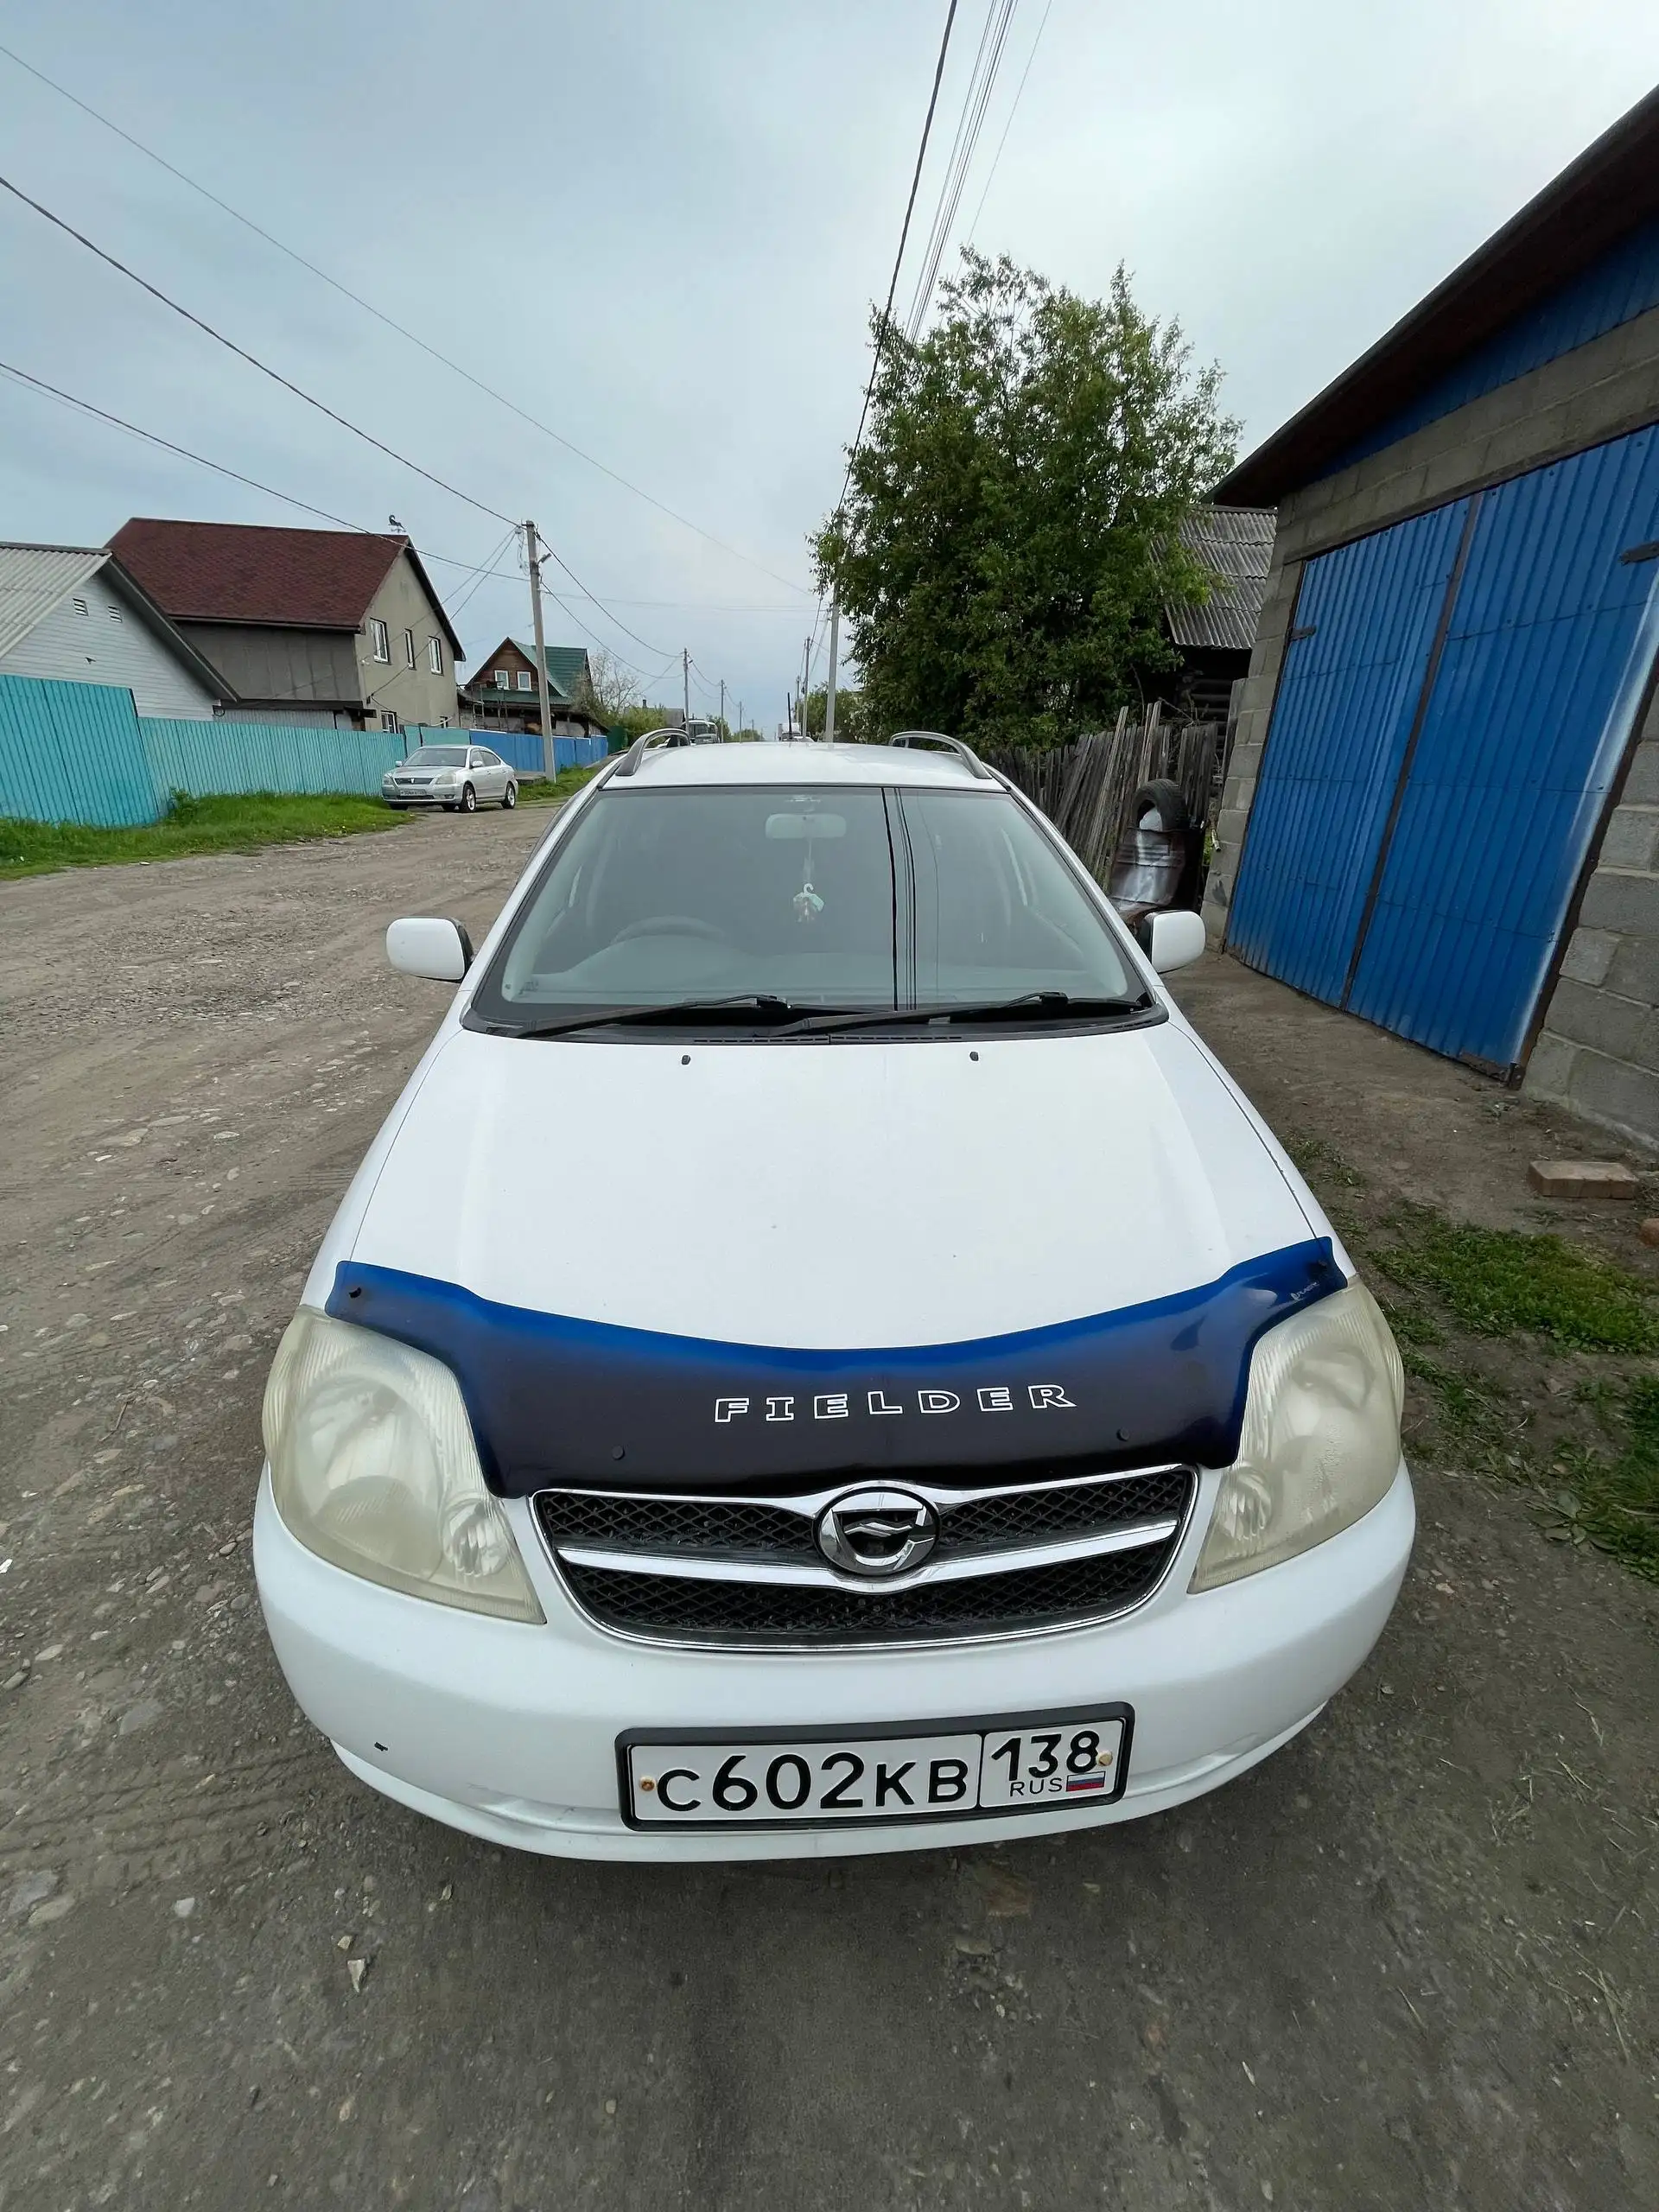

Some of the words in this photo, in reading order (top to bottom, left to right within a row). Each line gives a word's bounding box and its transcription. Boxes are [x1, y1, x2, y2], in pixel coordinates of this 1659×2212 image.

[715, 1384, 1077, 1423] FIELDER
[991, 1731, 1100, 1781] 138
[1009, 1777, 1063, 1797] RUS
